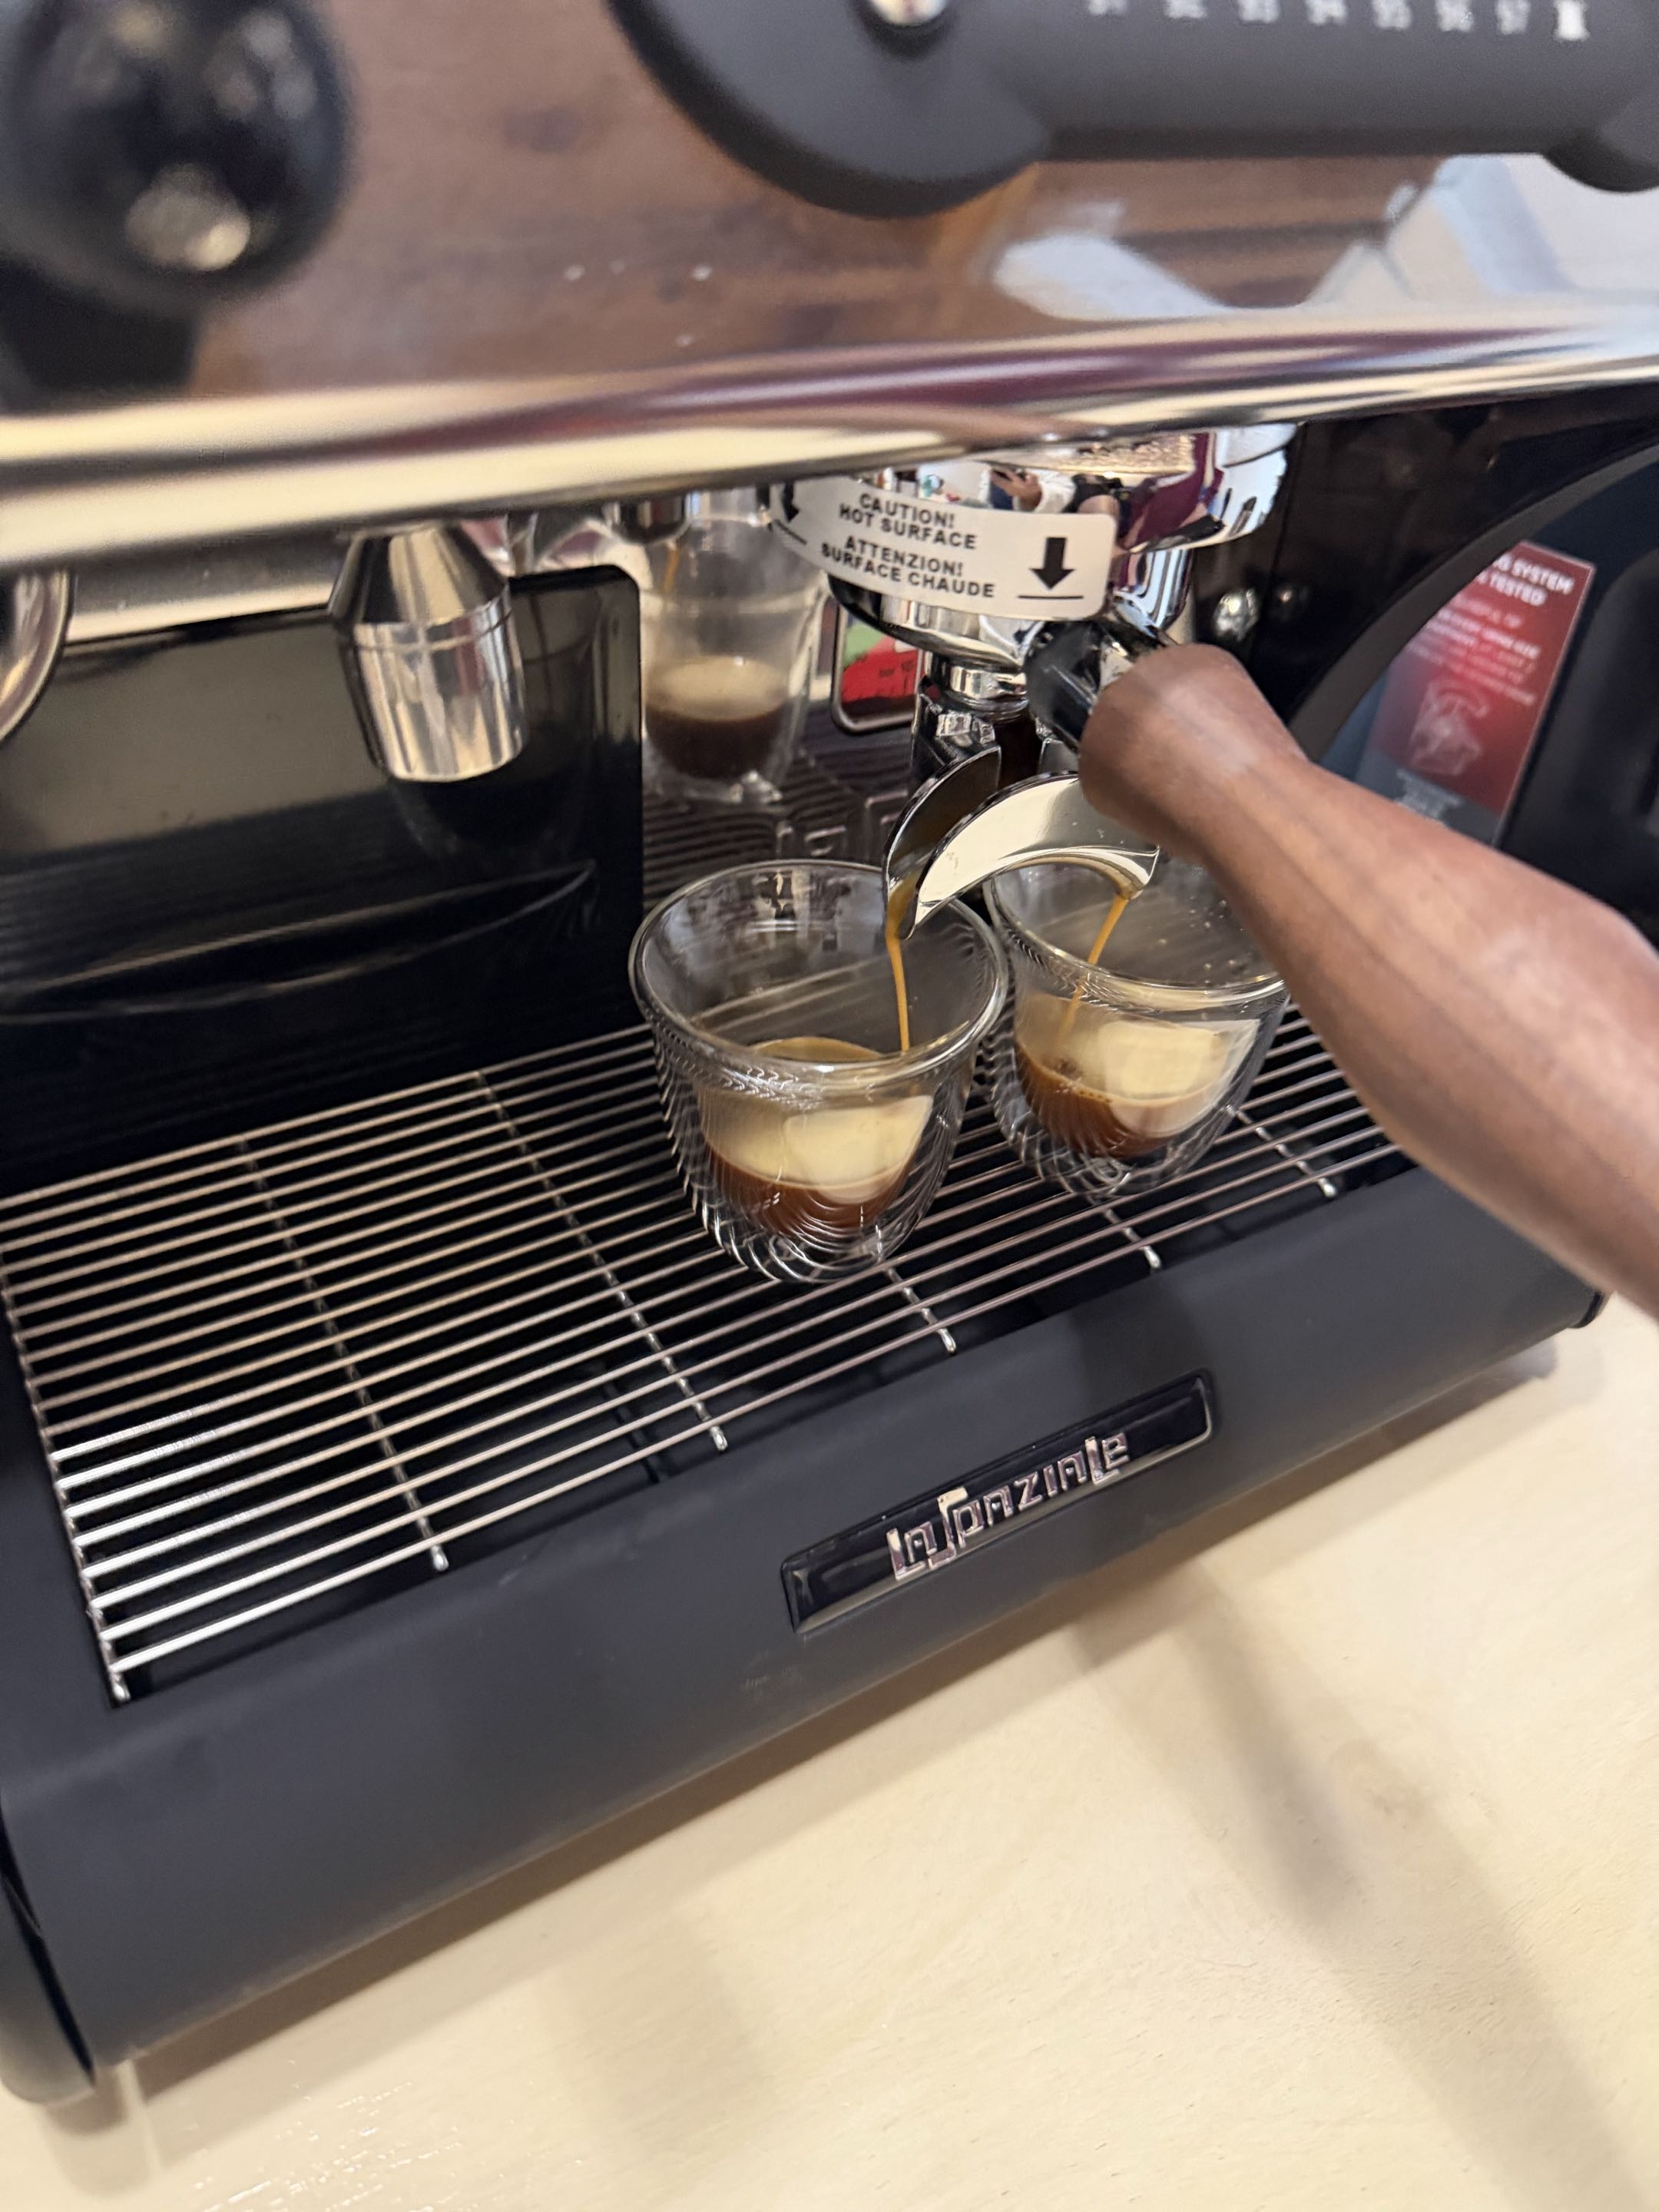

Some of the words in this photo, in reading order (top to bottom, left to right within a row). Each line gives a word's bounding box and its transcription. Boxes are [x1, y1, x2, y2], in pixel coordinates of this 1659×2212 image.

[839, 503, 874, 528] HOT
[880, 518, 978, 550] SURFACE
[859, 492, 955, 529] CAUTION!
[820, 542, 902, 583] SURFACE
[907, 571, 995, 598] CHAUDE
[845, 535, 964, 577] ATTENZION!
[1511, 558, 1575, 595] SYSTEM
